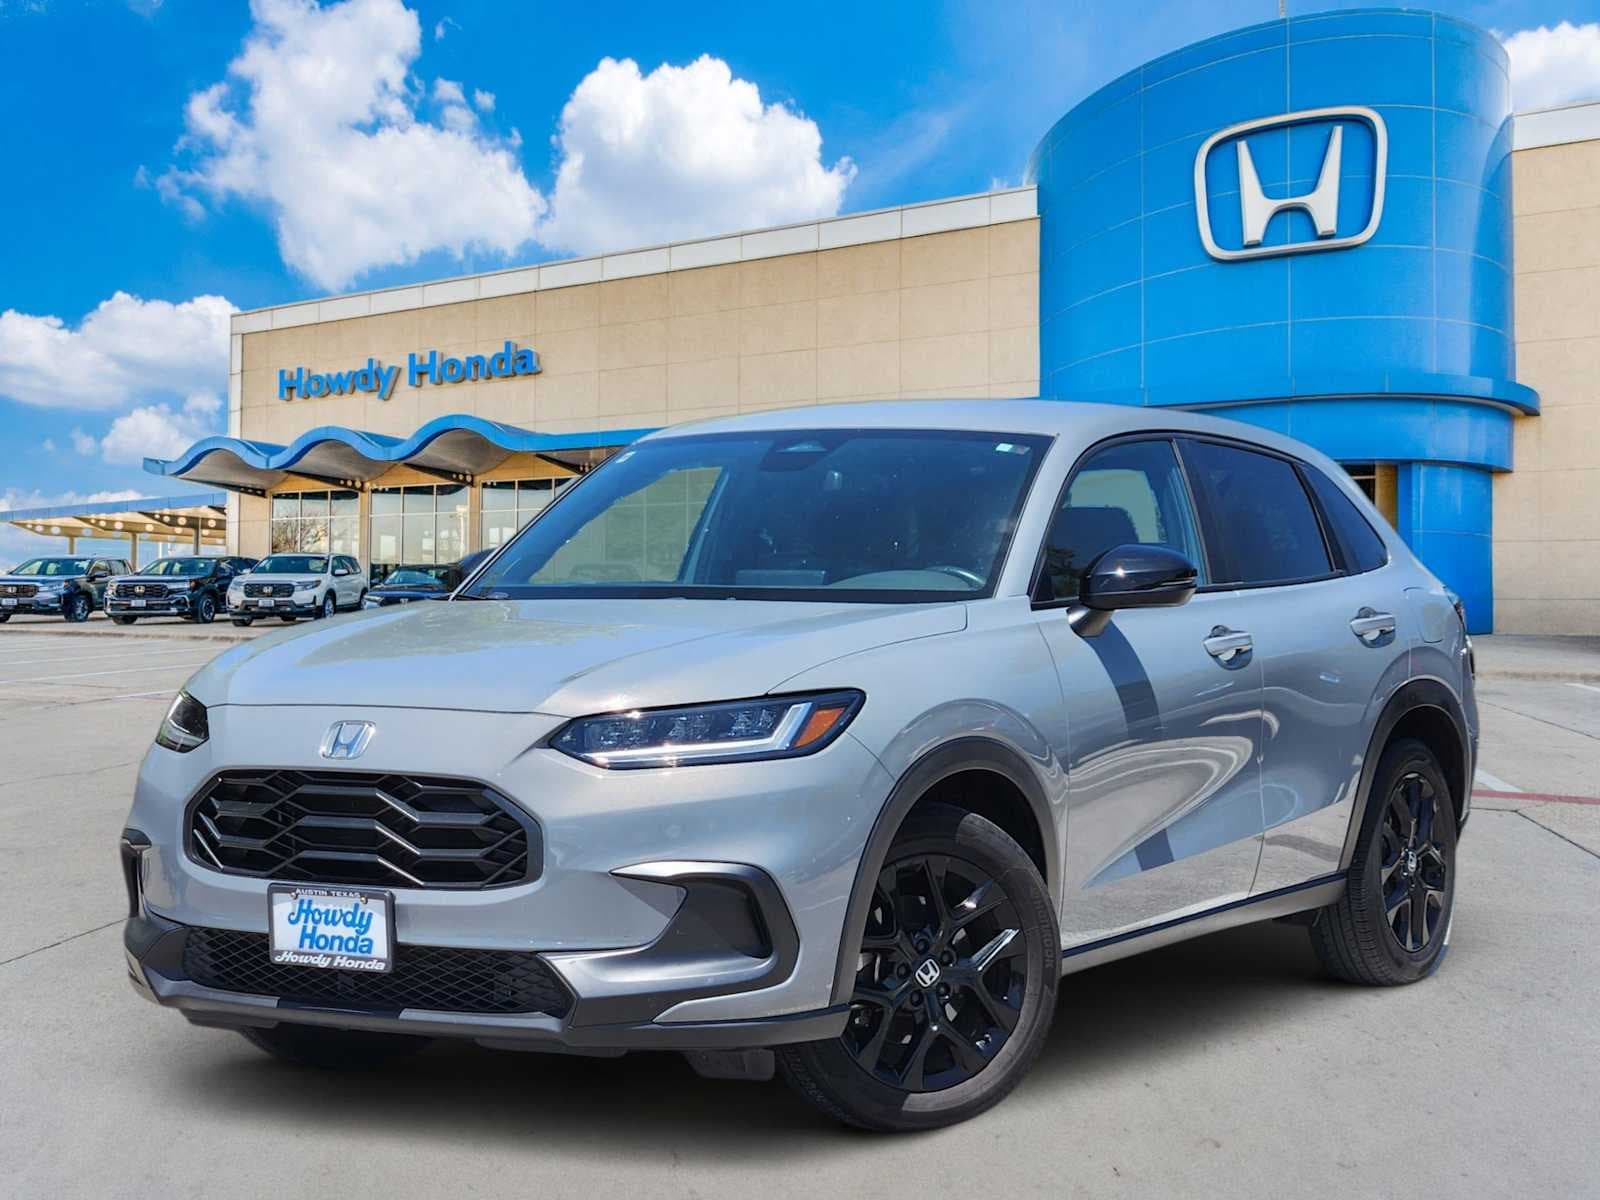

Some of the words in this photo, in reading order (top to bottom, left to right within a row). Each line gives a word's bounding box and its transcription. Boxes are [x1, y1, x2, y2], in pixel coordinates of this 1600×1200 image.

[278, 358, 401, 400] Howdy
[408, 341, 542, 387] Honda
[296, 888, 327, 896] AUSTIN
[288, 899, 373, 935] Howdy
[299, 925, 373, 954] Honda
[275, 951, 331, 967] Howdy
[333, 956, 386, 970] Honda
